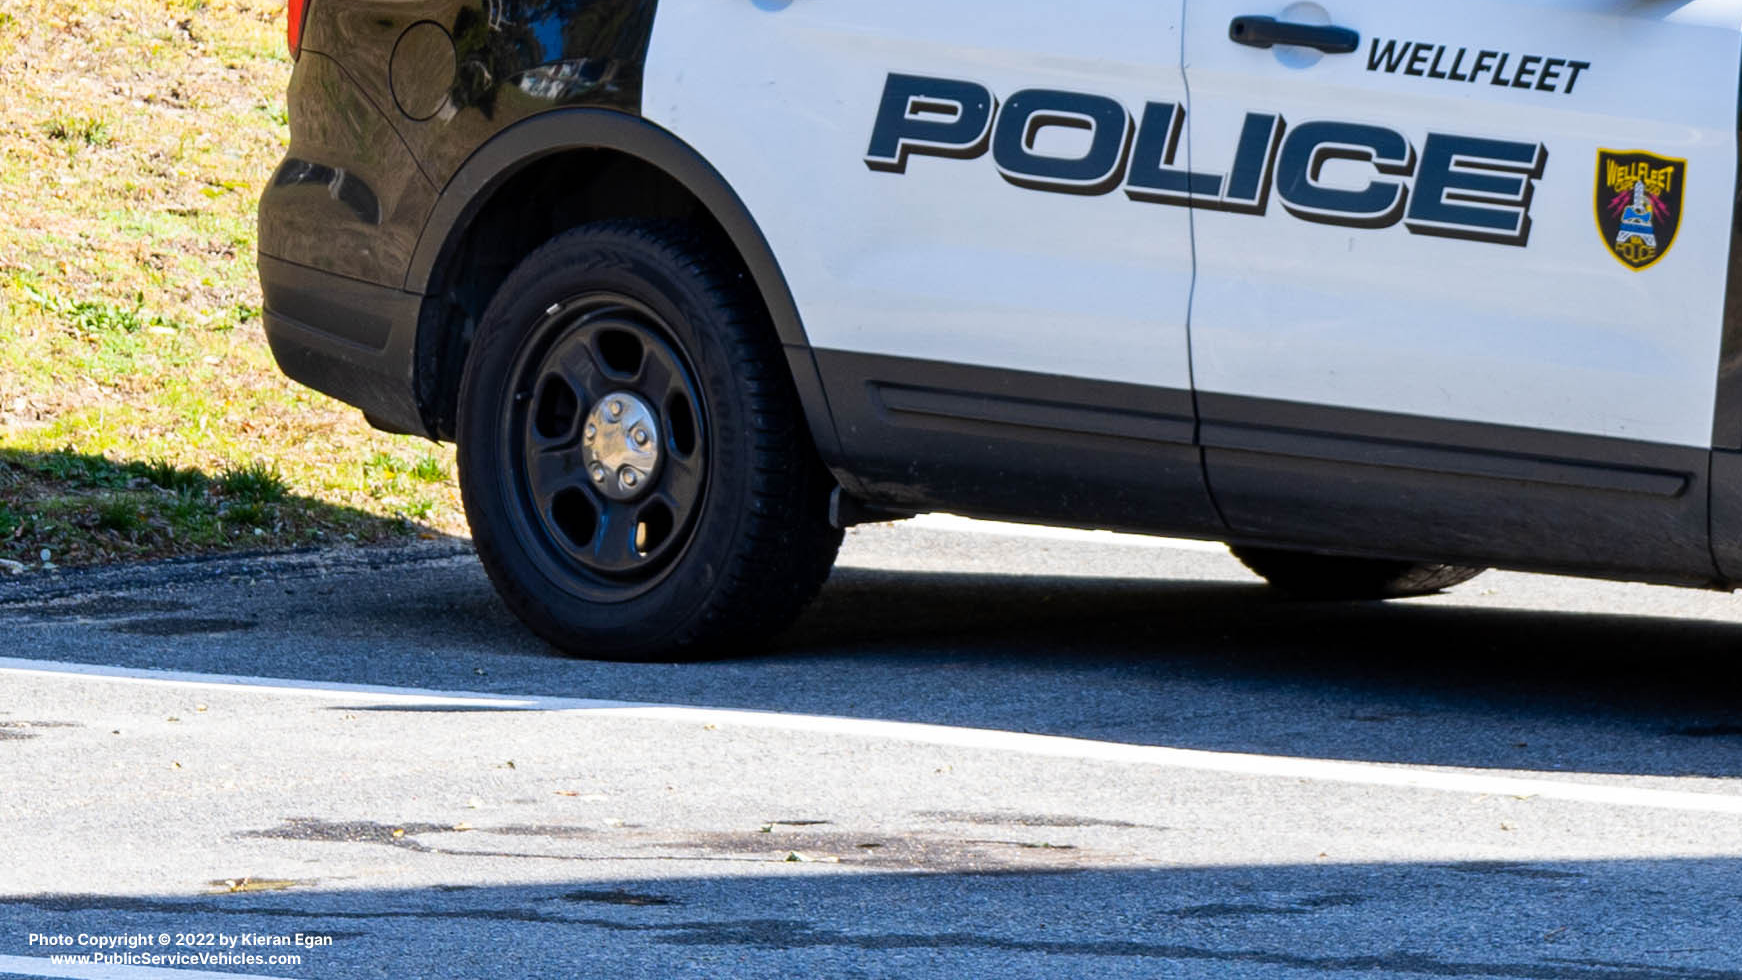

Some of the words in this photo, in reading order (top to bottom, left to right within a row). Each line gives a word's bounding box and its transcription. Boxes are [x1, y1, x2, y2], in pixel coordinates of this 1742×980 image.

[1366, 38, 1591, 94] WELLFLEET
[863, 71, 1548, 247] POLICE
[1606, 158, 1675, 192] WELLFLEET
